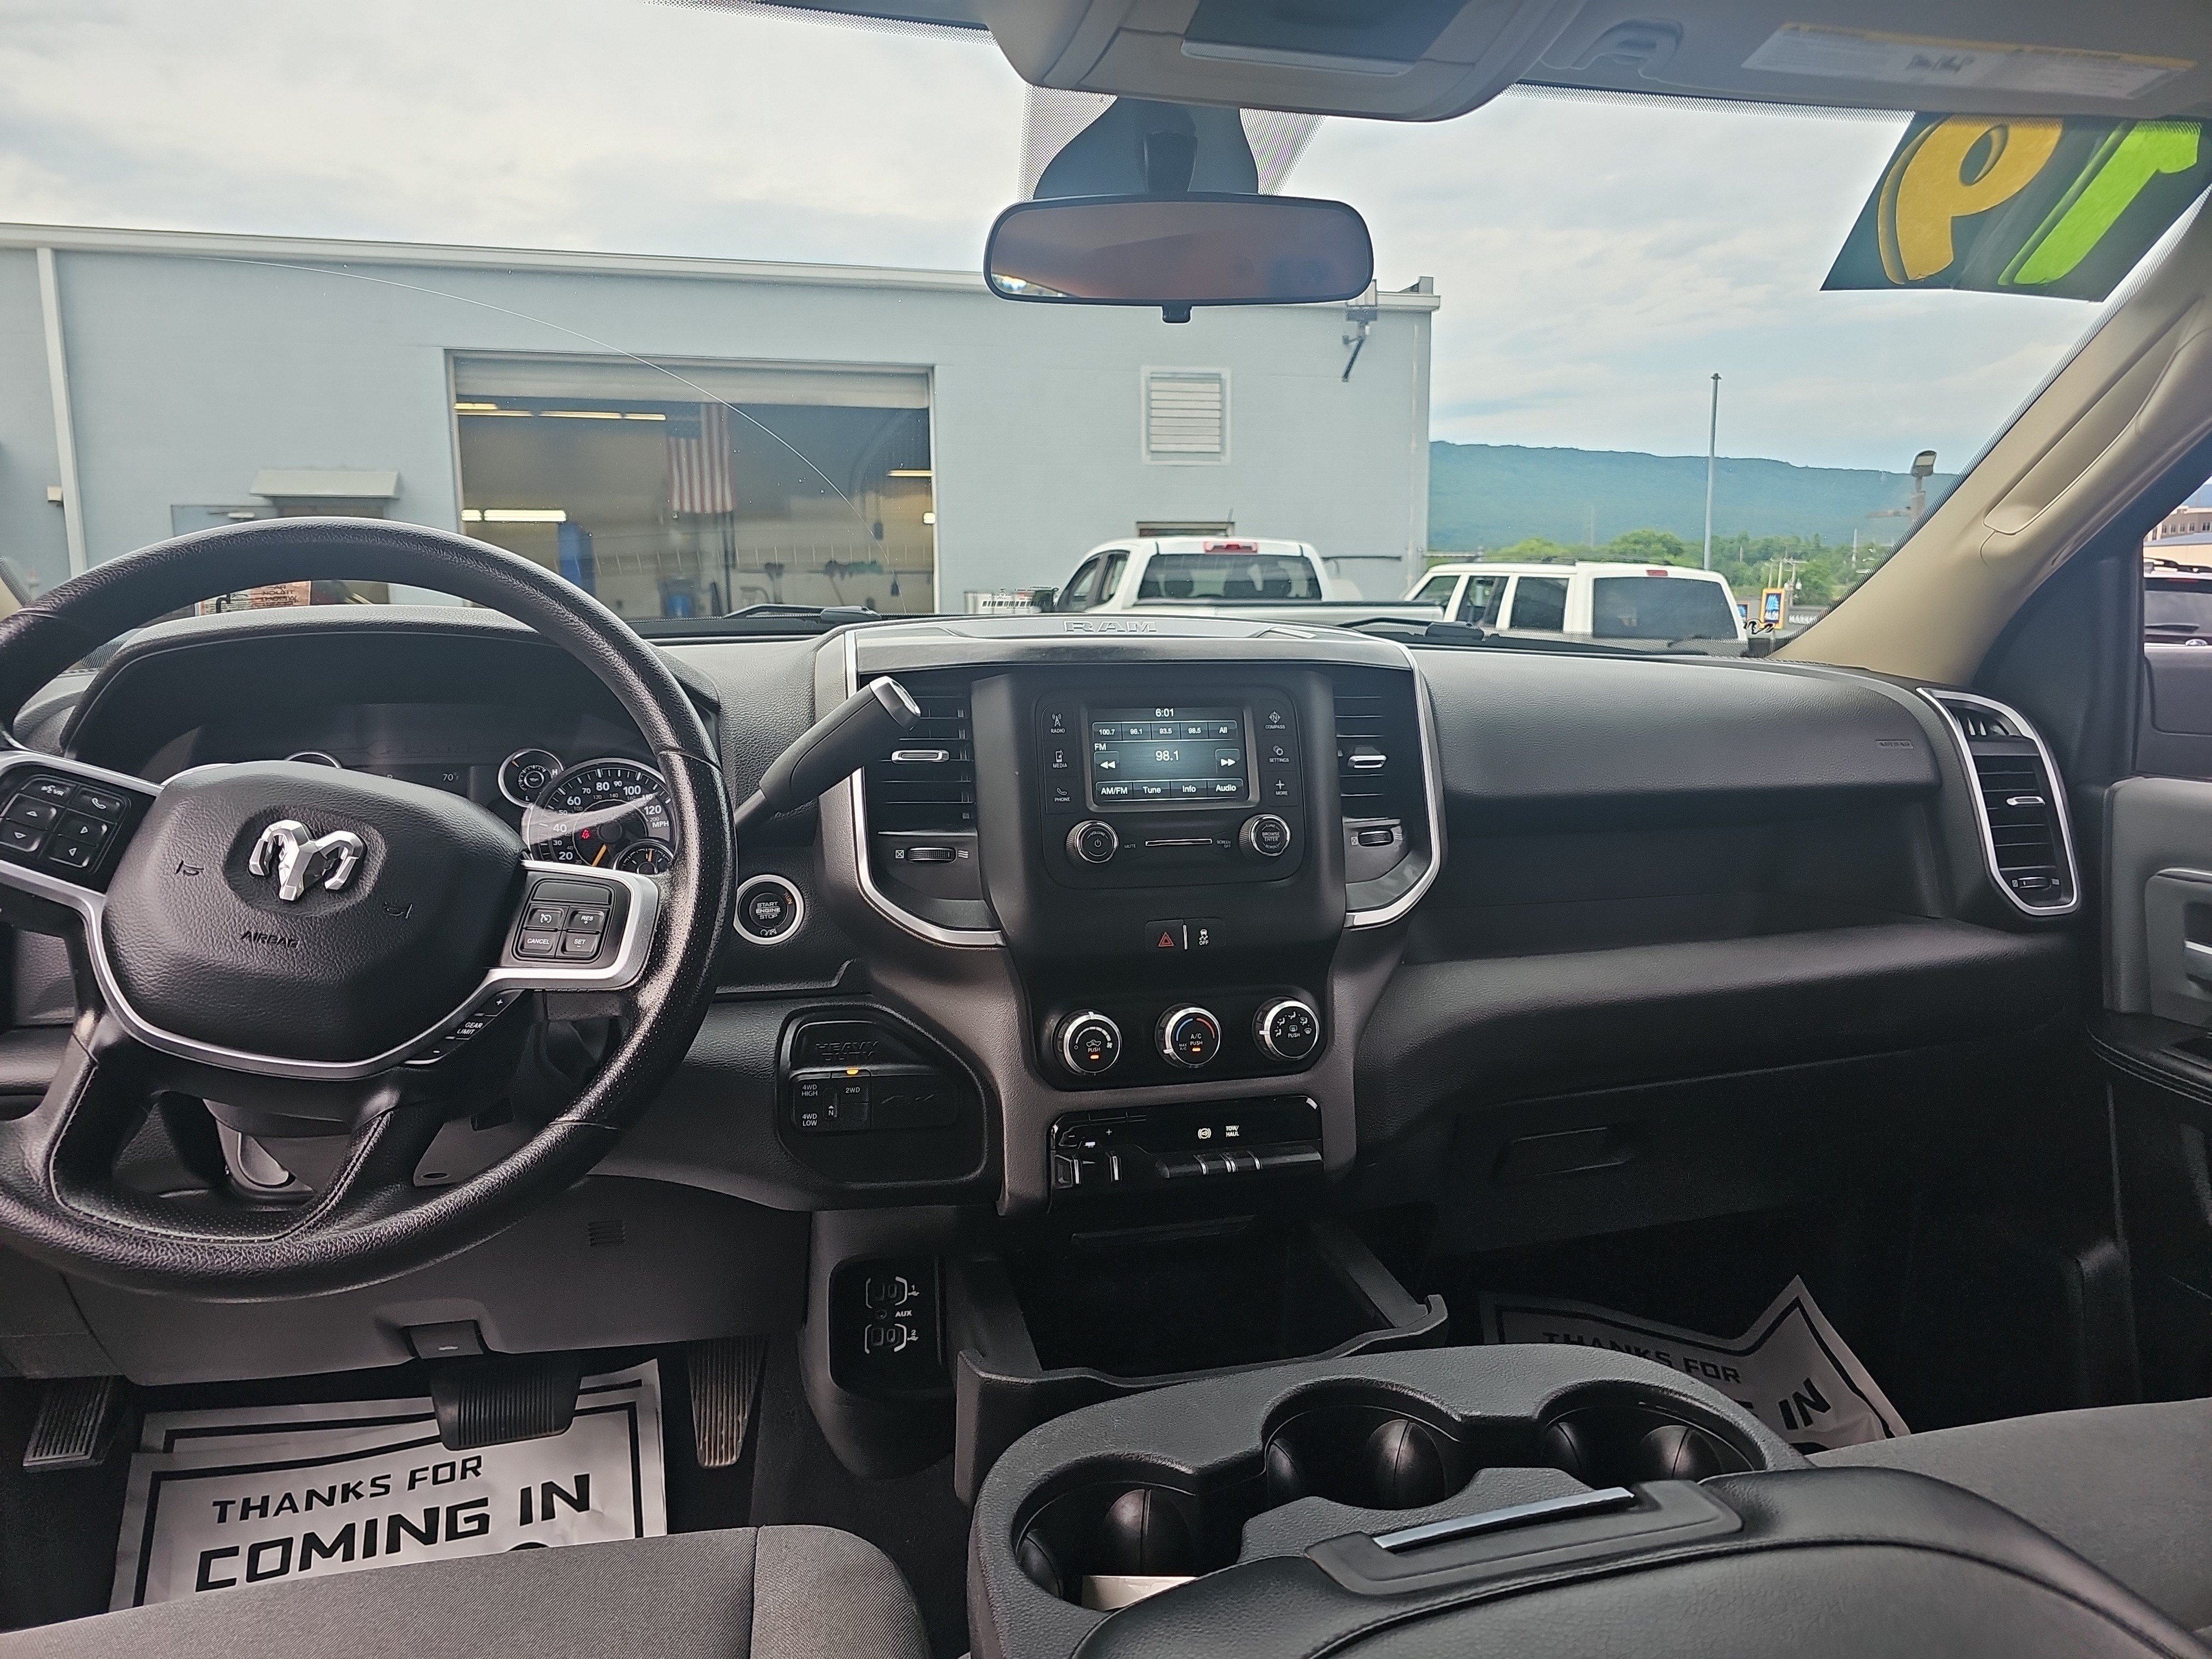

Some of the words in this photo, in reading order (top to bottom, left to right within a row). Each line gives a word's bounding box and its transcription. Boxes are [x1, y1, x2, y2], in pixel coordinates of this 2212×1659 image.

[1064, 621, 1157, 632] RAM
[1155, 708, 1174, 718] 6:01
[1155, 750, 1179, 761] 98.1
[596, 782, 610, 791] 80
[623, 785, 641, 796] 100
[1101, 787, 1128, 795] AM/FM
[1216, 784, 1237, 792] Audio
[567, 796, 581, 806] 60
[644, 805, 662, 815] 120
[553, 824, 567, 833] 40
[652, 820, 670, 828] MPH
[558, 851, 573, 860] 20
[240, 931, 300, 949] AIRBAG
[1683, 1357, 1741, 1384] FOR
[1778, 1377, 1832, 1431] IN
[212, 1473, 391, 1524] THANKS
[407, 1455, 483, 1492] FOR
[194, 1497, 491, 1593] COMING
[518, 1473, 591, 1527] IN
